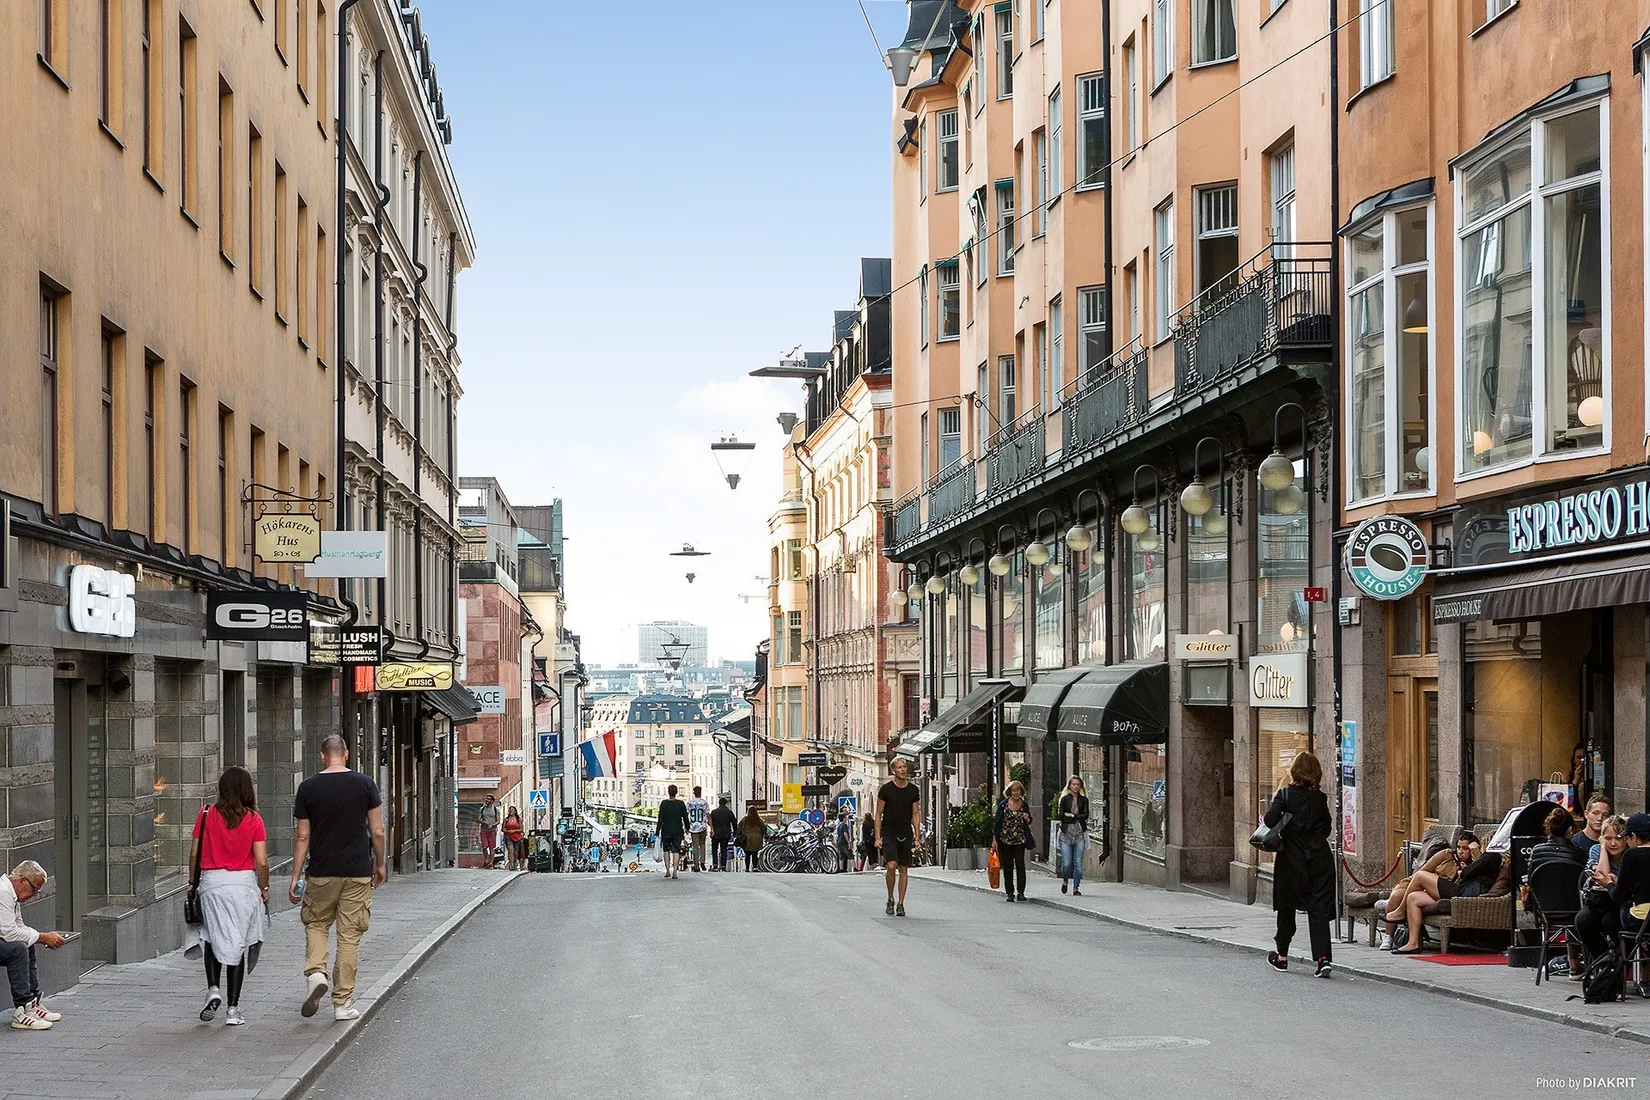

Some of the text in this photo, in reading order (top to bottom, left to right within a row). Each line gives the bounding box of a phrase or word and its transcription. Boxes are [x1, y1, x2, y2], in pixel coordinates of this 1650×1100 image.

[261, 517, 315, 536] Hökarens
[1507, 481, 1650, 553] ESPRESSO H
[277, 535, 299, 546] Hus
[1354, 520, 1423, 552] ESPRESSO
[1363, 574, 1417, 595] HOUSE
[70, 564, 136, 638] G26
[1307, 591, 1320, 600] 1,4
[1435, 599, 1482, 620] ESPRESSO HOUSE
[342, 632, 378, 643] LUSH
[1185, 641, 1232, 652] Glitter
[1253, 664, 1293, 700] Glitter
[505, 753, 523, 762] ebba
[690, 808, 703, 823] 90
